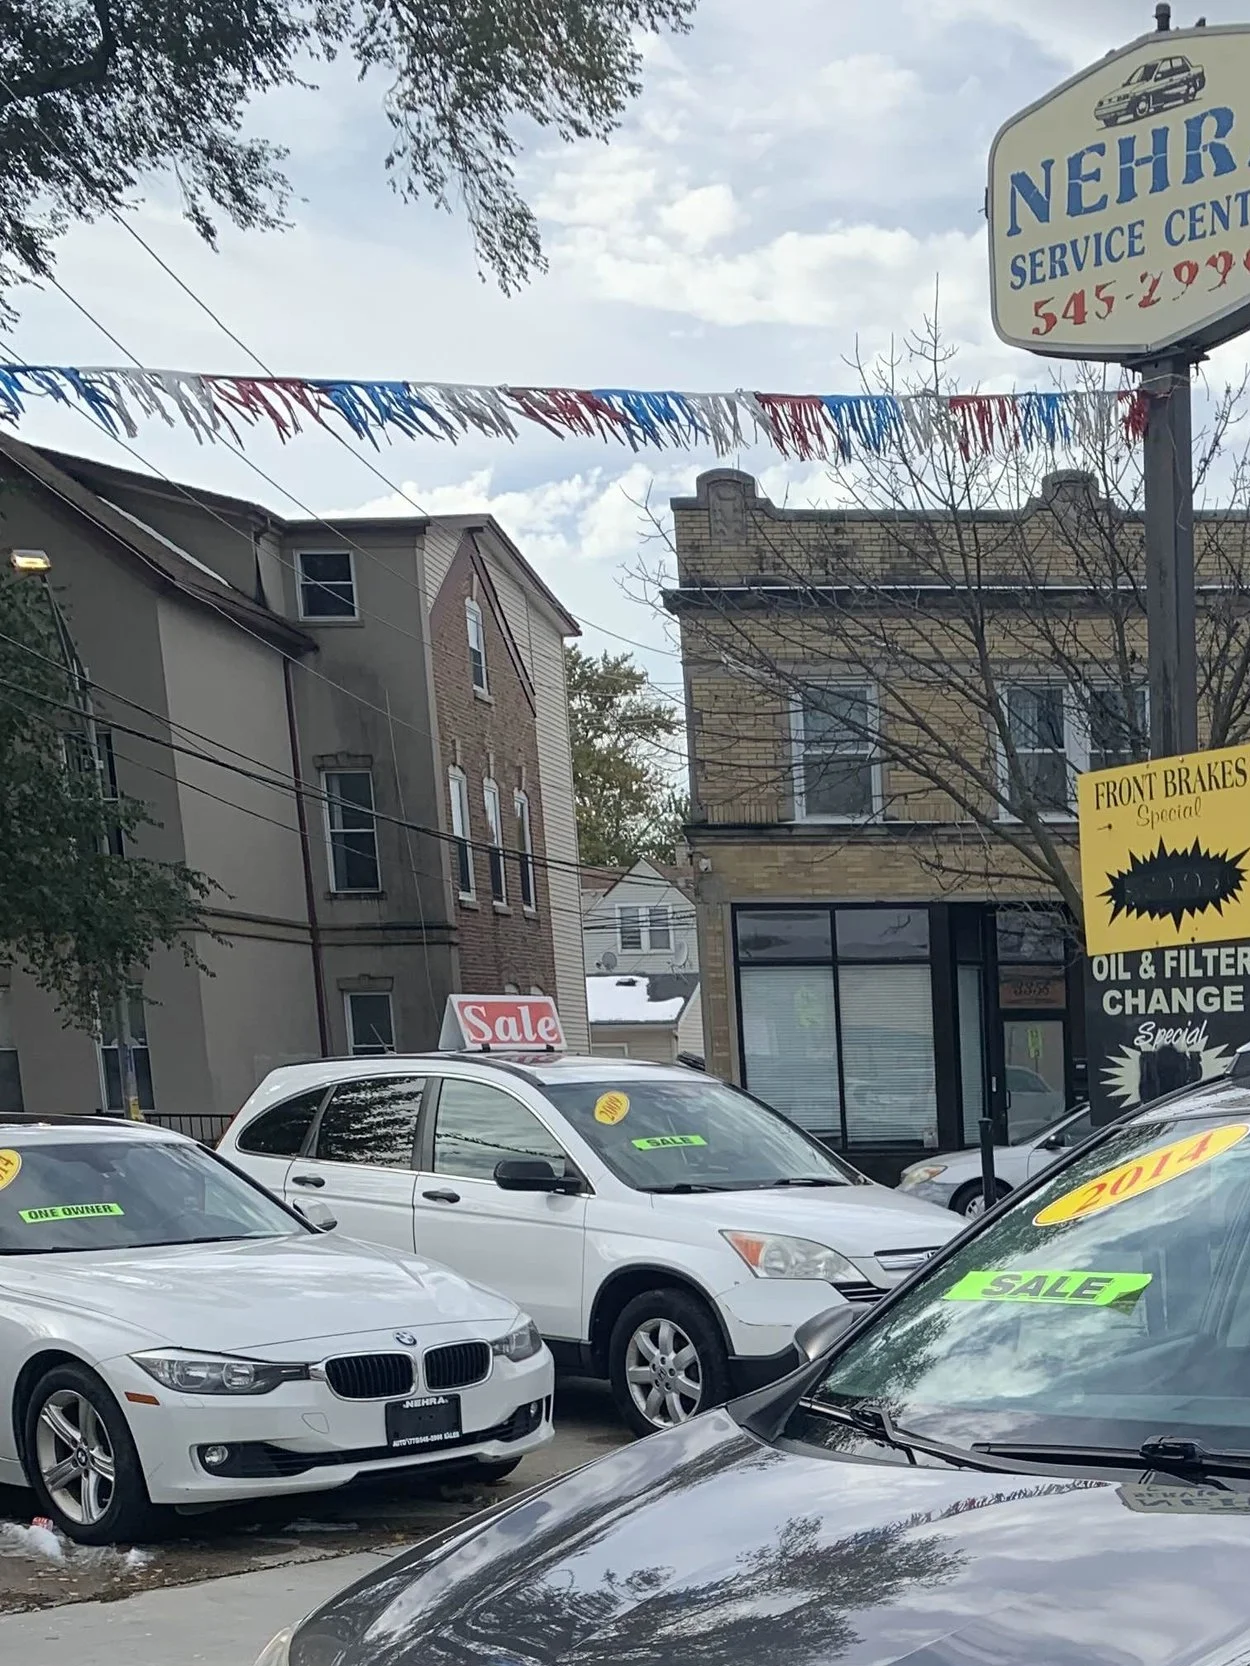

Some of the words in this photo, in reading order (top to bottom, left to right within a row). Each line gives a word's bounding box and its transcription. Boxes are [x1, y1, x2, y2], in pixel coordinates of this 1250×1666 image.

[1010, 220, 1145, 290] SERVICE
[1094, 772, 1157, 811] FRONT
[1164, 757, 1247, 799] BRAKES
[1136, 797, 1202, 830] Special
[1092, 953, 1131, 981] OIL
[1139, 951, 1156, 980] &
[1102, 986, 1245, 1016] CHANGE
[462, 1004, 559, 1042] Sale
[1134, 1020, 1210, 1048] Special
[647, 1136, 693, 1147] SALE
[1071, 1131, 1214, 1215] 2014
[28, 1209, 58, 1220] ONE
[61, 1204, 113, 1216] OWNER
[981, 1273, 1115, 1300] SALE
[405, 1396, 446, 1408] NEHRA
